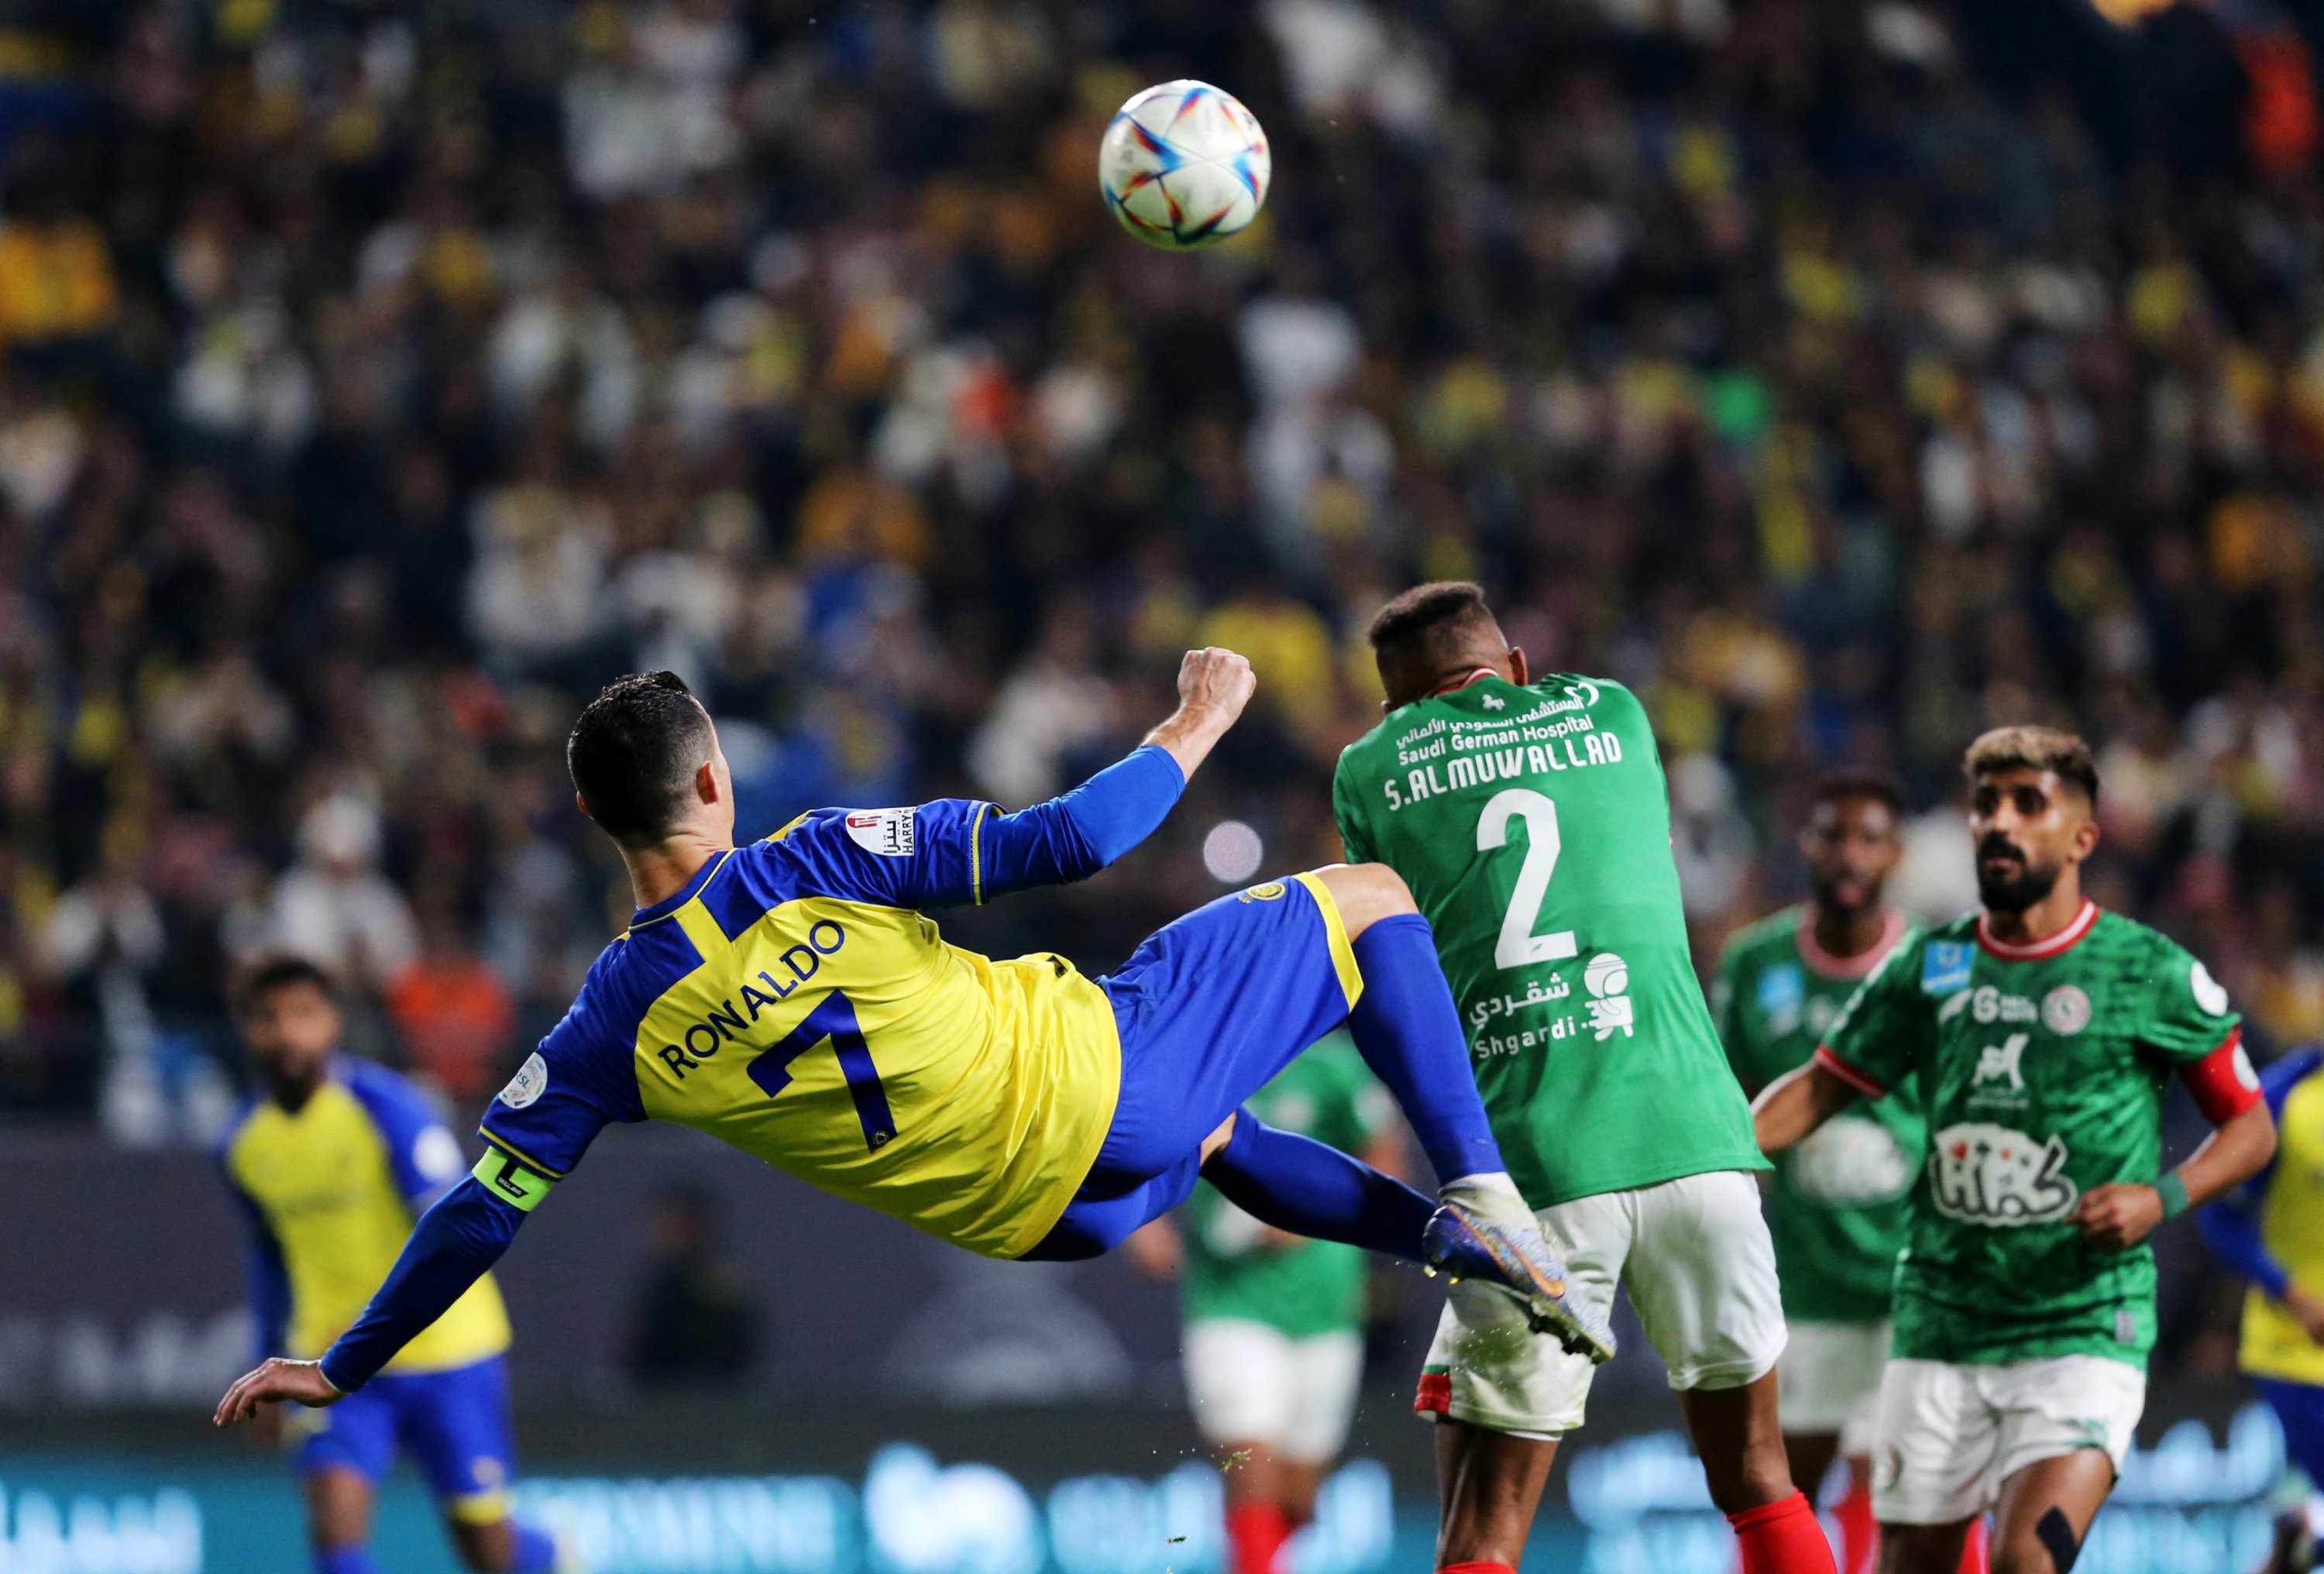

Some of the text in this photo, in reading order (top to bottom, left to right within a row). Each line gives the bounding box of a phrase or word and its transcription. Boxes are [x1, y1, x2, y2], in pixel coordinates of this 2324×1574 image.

[1384, 731, 1623, 812] S.ALMUWALLAD
[1397, 714, 1594, 766] Saudi German Hospital
[1476, 788, 1577, 970] 2
[658, 919, 844, 1079] RONALDO
[1470, 972, 1570, 1029] شقردي
[1476, 1016, 1576, 1059] Shgardi
[746, 988, 898, 1154] 7
